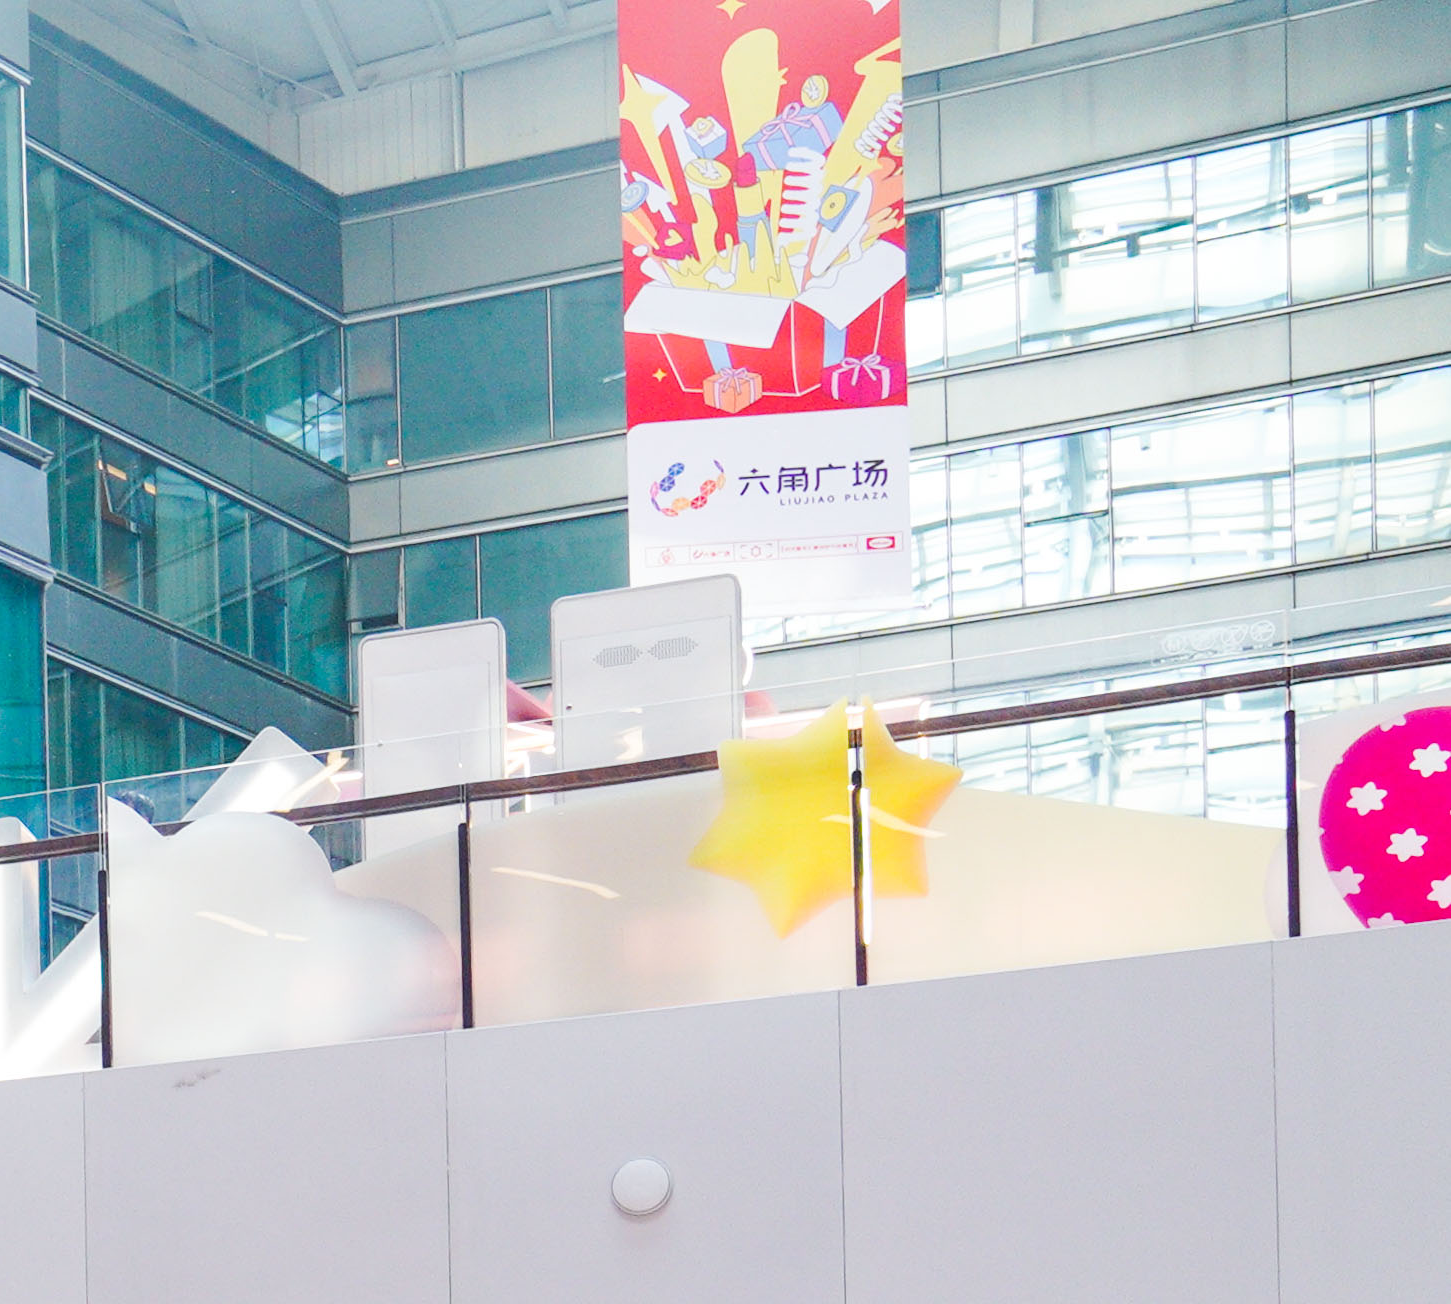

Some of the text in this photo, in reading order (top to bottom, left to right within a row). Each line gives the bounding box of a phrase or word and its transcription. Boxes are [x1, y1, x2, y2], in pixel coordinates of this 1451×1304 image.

[738, 459, 888, 496] 六角广场
[779, 490, 889, 507] LIUJIAO PLAZA
